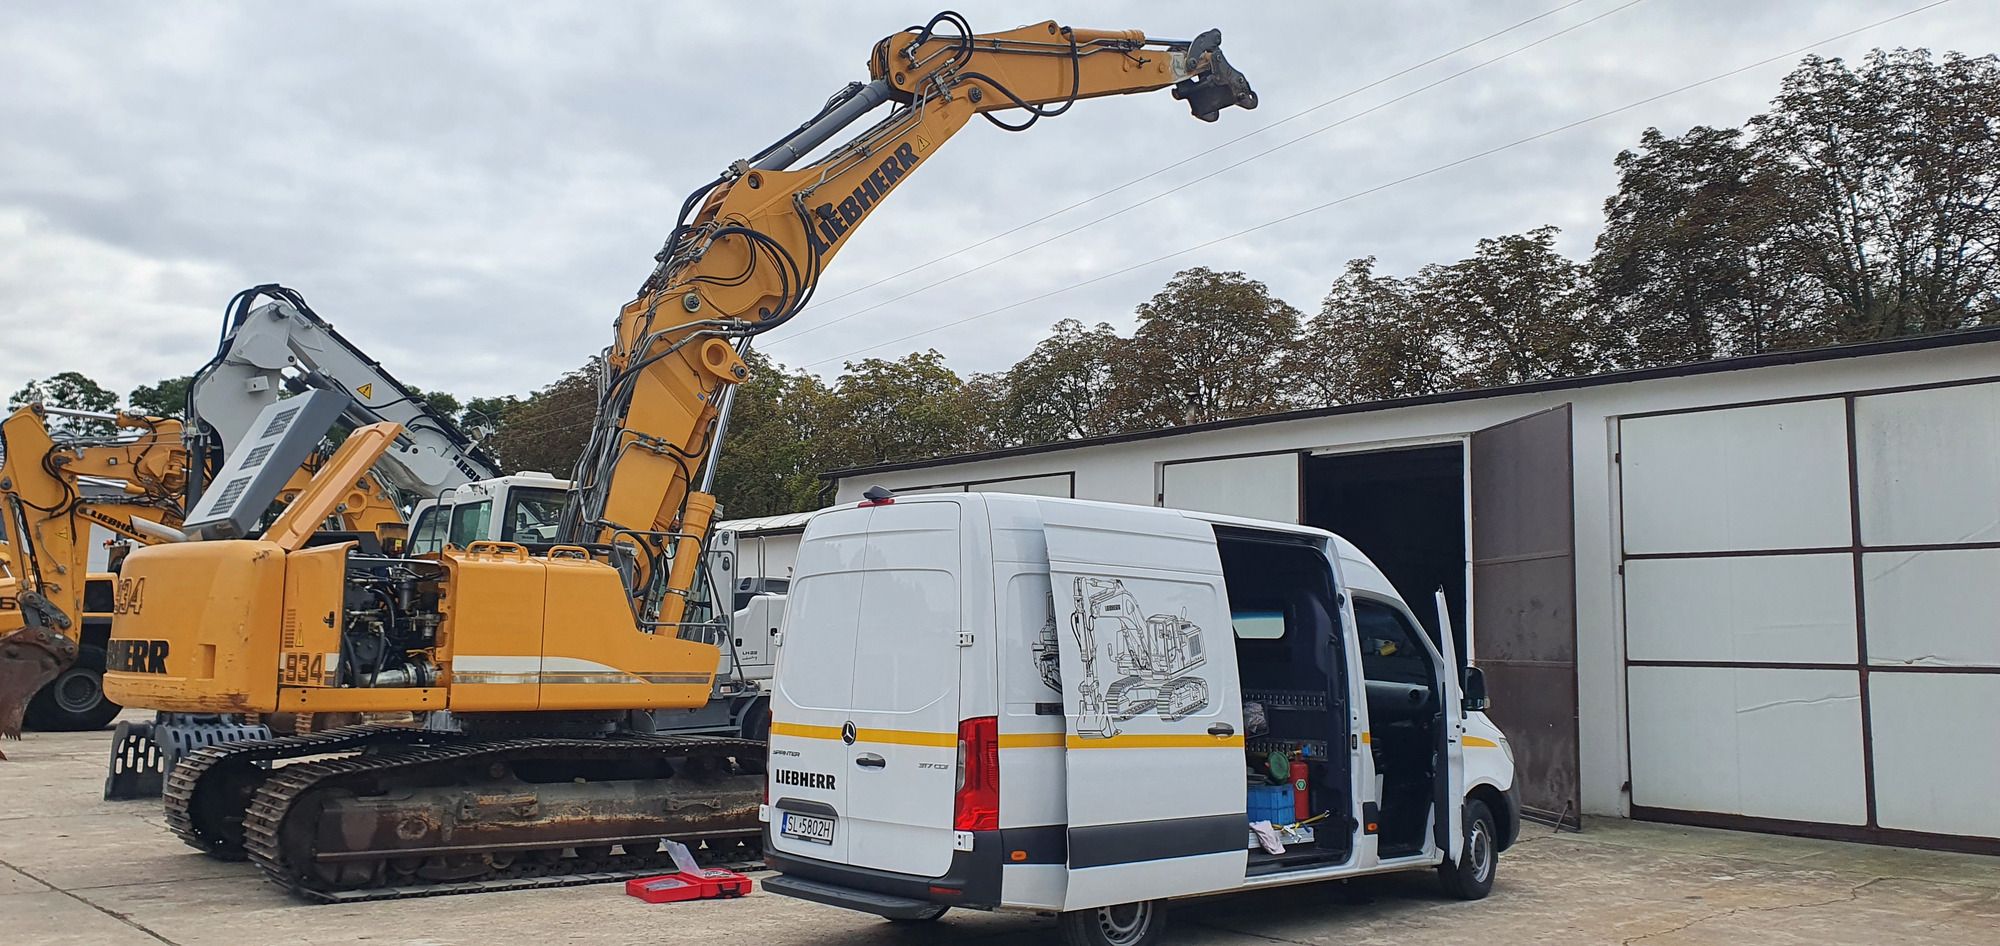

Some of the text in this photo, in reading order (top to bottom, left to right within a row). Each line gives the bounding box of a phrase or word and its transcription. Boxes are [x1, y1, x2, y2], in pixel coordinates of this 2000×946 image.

[813, 142, 919, 256] LIEBHERR
[285, 653, 323, 685] 934
[775, 768, 836, 790] LIEBHERR
[788, 816, 831, 838] SL 5802H
